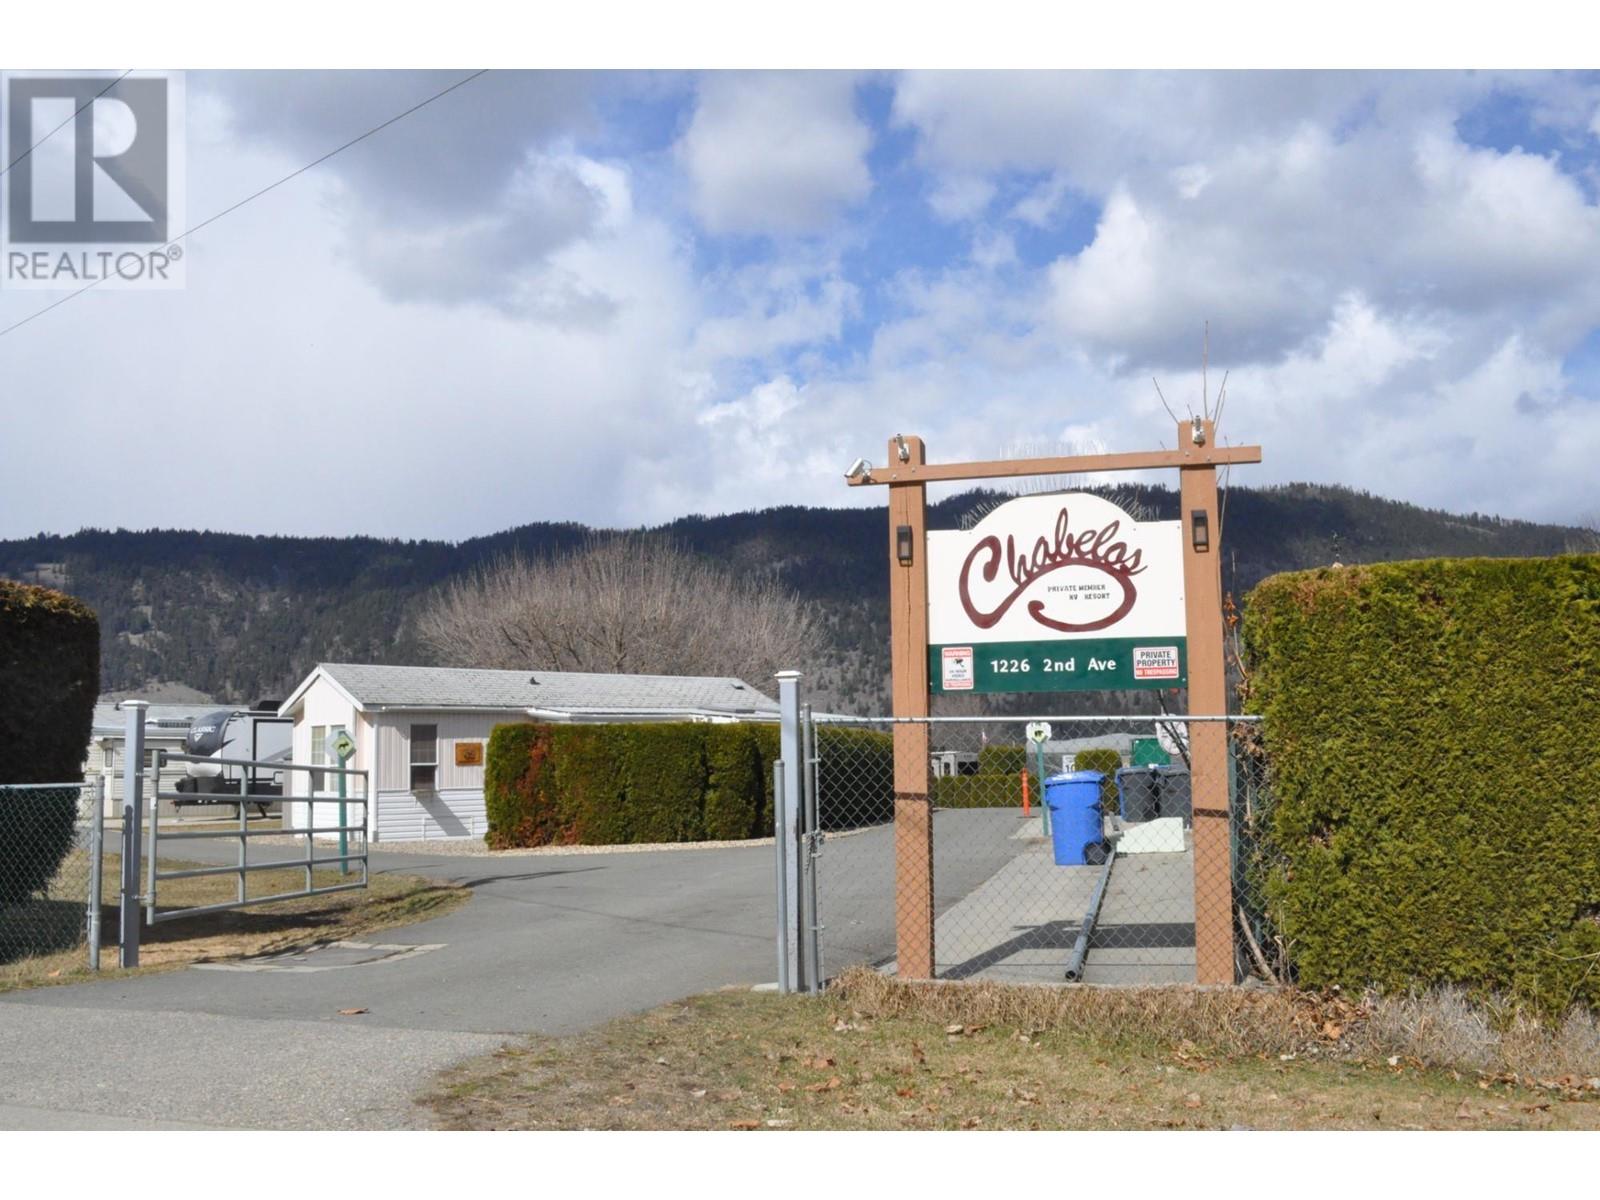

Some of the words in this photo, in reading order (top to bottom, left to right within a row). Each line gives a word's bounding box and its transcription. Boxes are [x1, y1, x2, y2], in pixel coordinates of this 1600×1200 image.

[990, 658, 1030, 673] 1226
[1043, 657, 1075, 672] 2nd
[1088, 657, 1117, 671] Ave
[1136, 659, 1175, 667] PROPERTY
